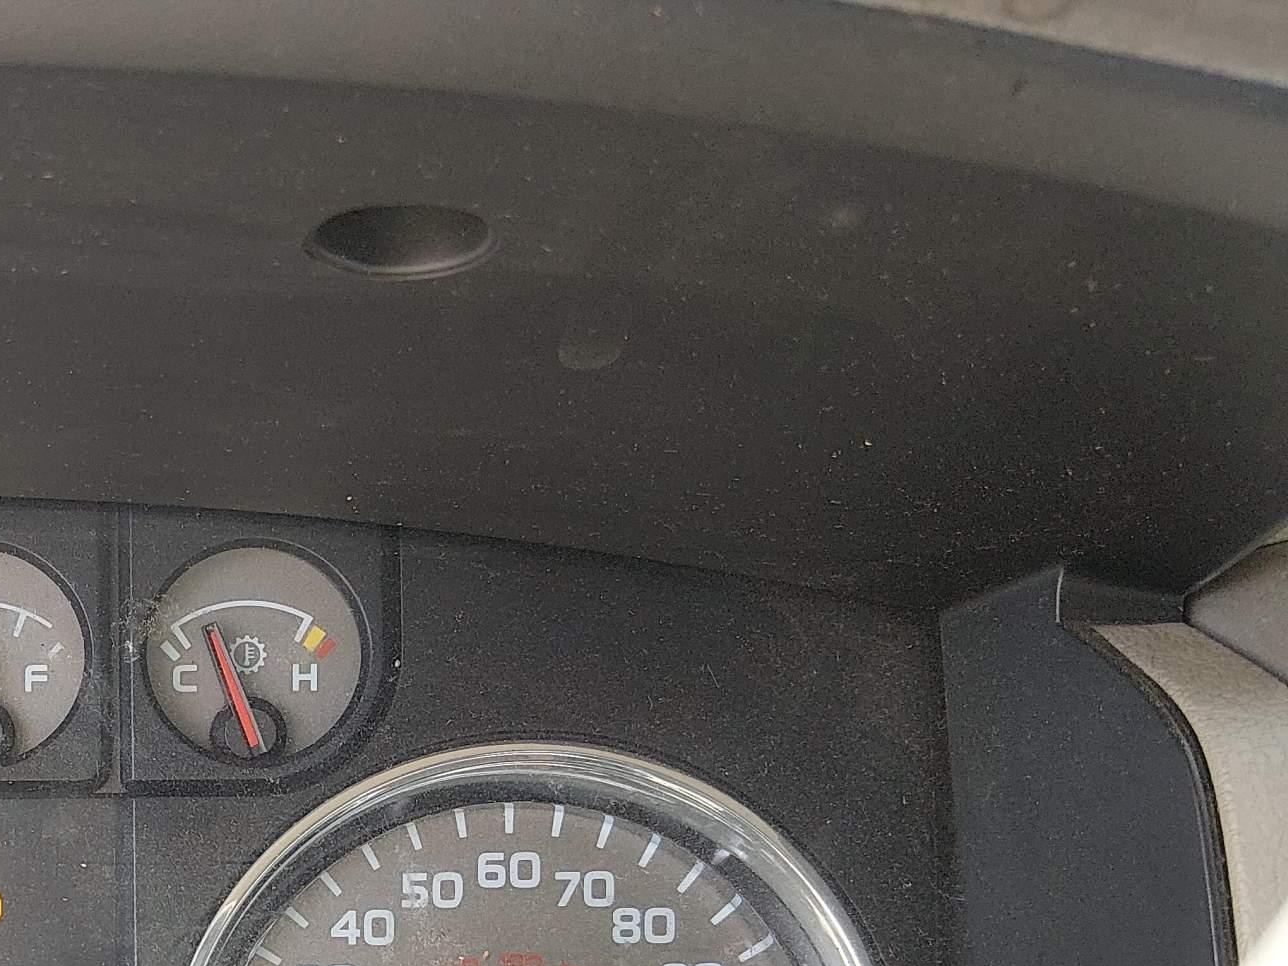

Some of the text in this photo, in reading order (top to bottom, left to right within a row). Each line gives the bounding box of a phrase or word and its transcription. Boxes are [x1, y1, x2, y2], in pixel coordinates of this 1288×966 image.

[24, 664, 48, 693] F
[172, 665, 198, 692] C
[292, 664, 318, 692] H
[477, 852, 541, 888] 60
[401, 872, 463, 909] 50
[554, 871, 615, 907] 70
[330, 910, 395, 945] 40
[612, 908, 676, 944] 80
